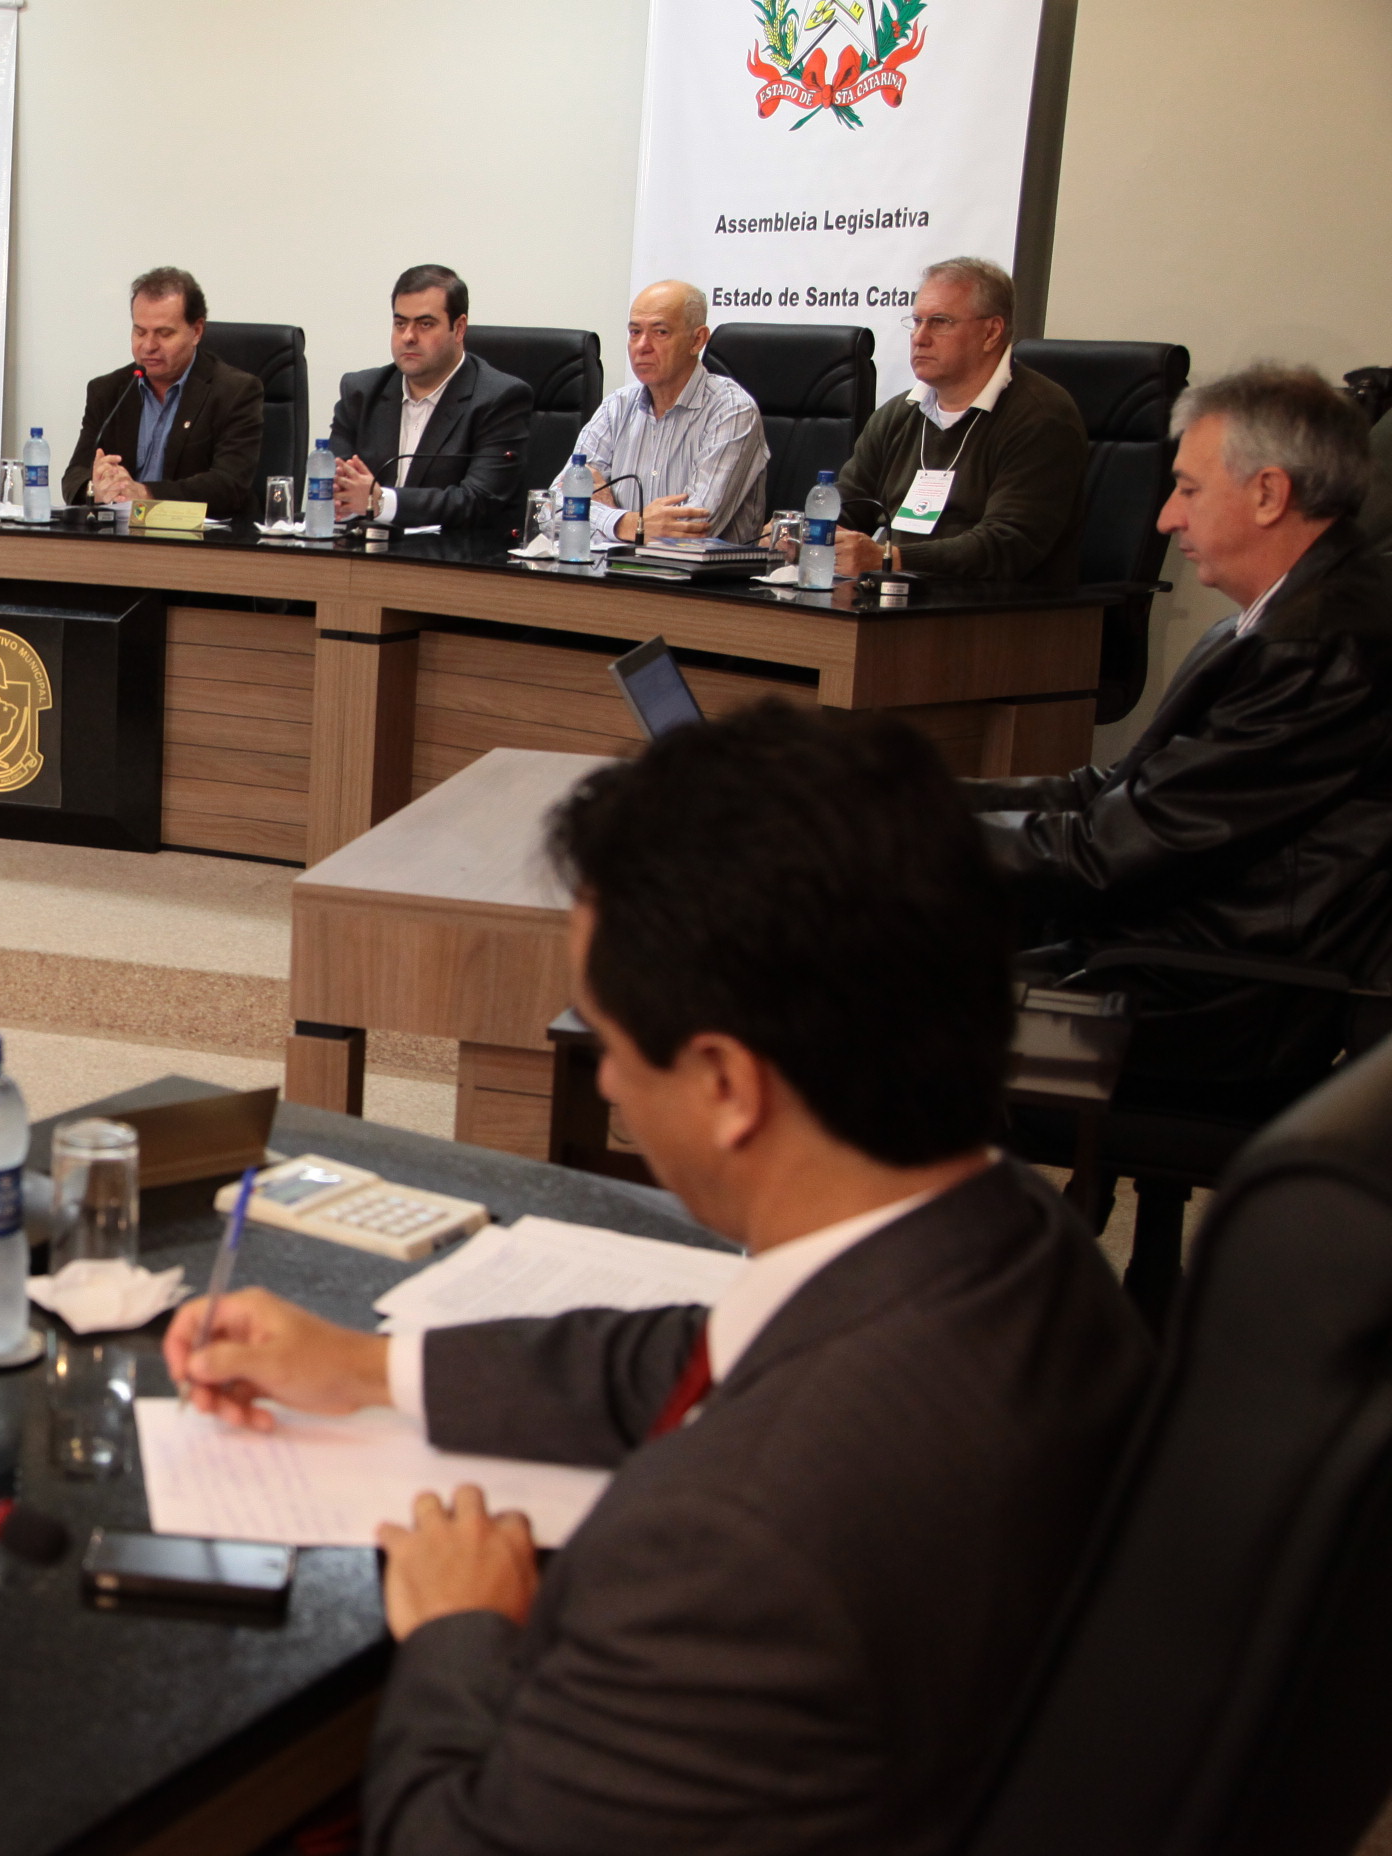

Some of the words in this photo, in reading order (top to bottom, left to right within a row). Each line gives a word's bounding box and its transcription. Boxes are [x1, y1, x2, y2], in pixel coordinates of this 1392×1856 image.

[759, 83, 799, 104] ESTADO
[799, 91, 814, 106] DE
[834, 91, 857, 105] STA.
[857, 72, 903, 97] CATARINA
[714, 211, 817, 234] Assembleia
[823, 207, 929, 235] Legislativa
[712, 287, 772, 306] Estado
[778, 287, 800, 307] de
[805, 286, 859, 307] Santa
[866, 286, 918, 306] Catar
[18, 647, 47, 703] MUNICIPAL
